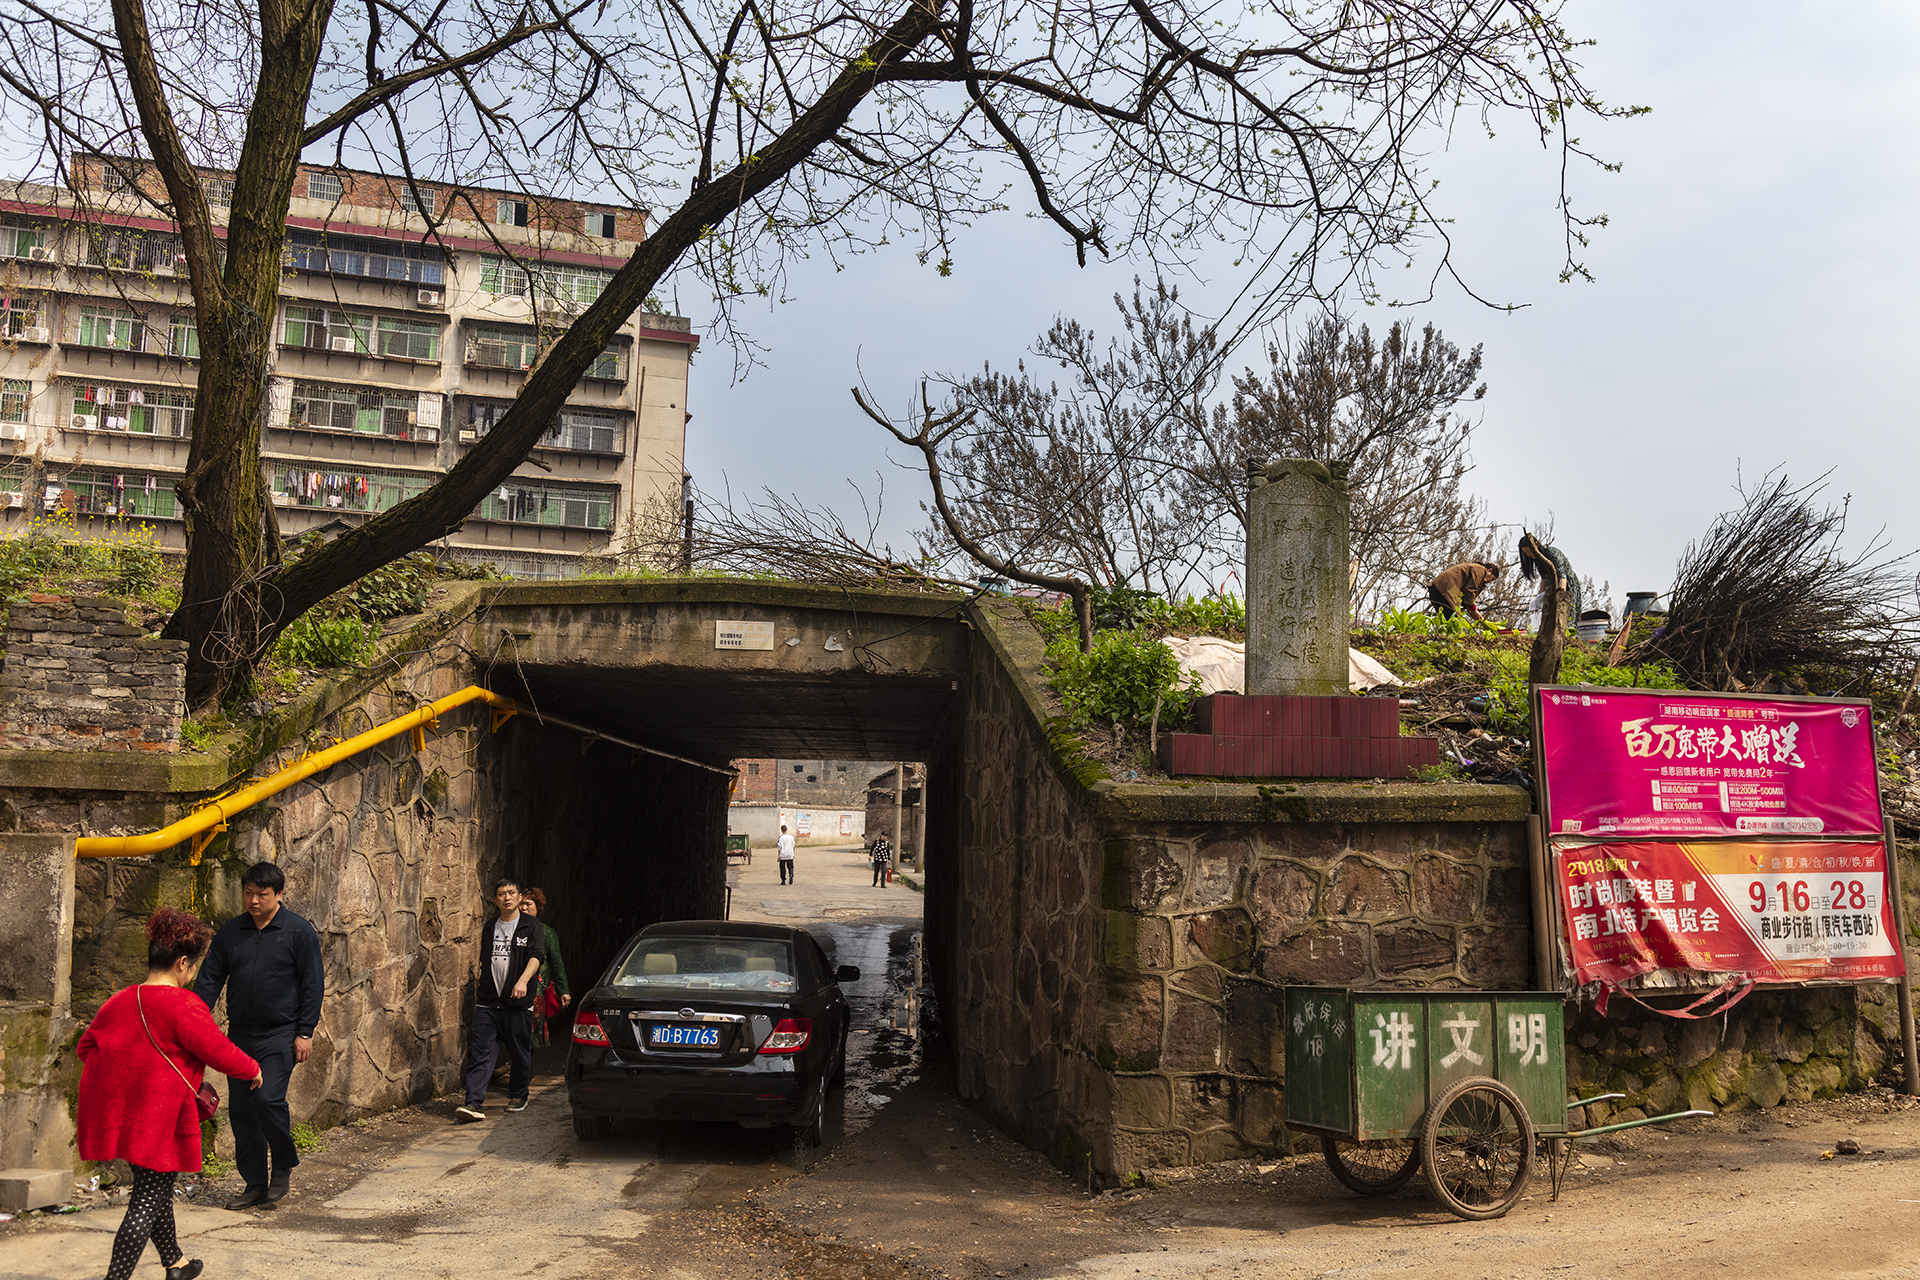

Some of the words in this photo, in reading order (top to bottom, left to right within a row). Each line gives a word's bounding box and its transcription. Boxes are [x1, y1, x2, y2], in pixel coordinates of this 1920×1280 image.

[1621, 716, 1805, 768] 百万宽带大赠送
[1660, 766, 1721, 777] 感恩回馈新老用户
[1723, 767, 1774, 778] 宽带免费用2年
[1568, 878, 1676, 909] 时尚服装暨
[1573, 907, 1720, 941] 南北特产博览会
[1310, 1038, 1324, 1057] 18
[1369, 1011, 1548, 1069] 讲文明
